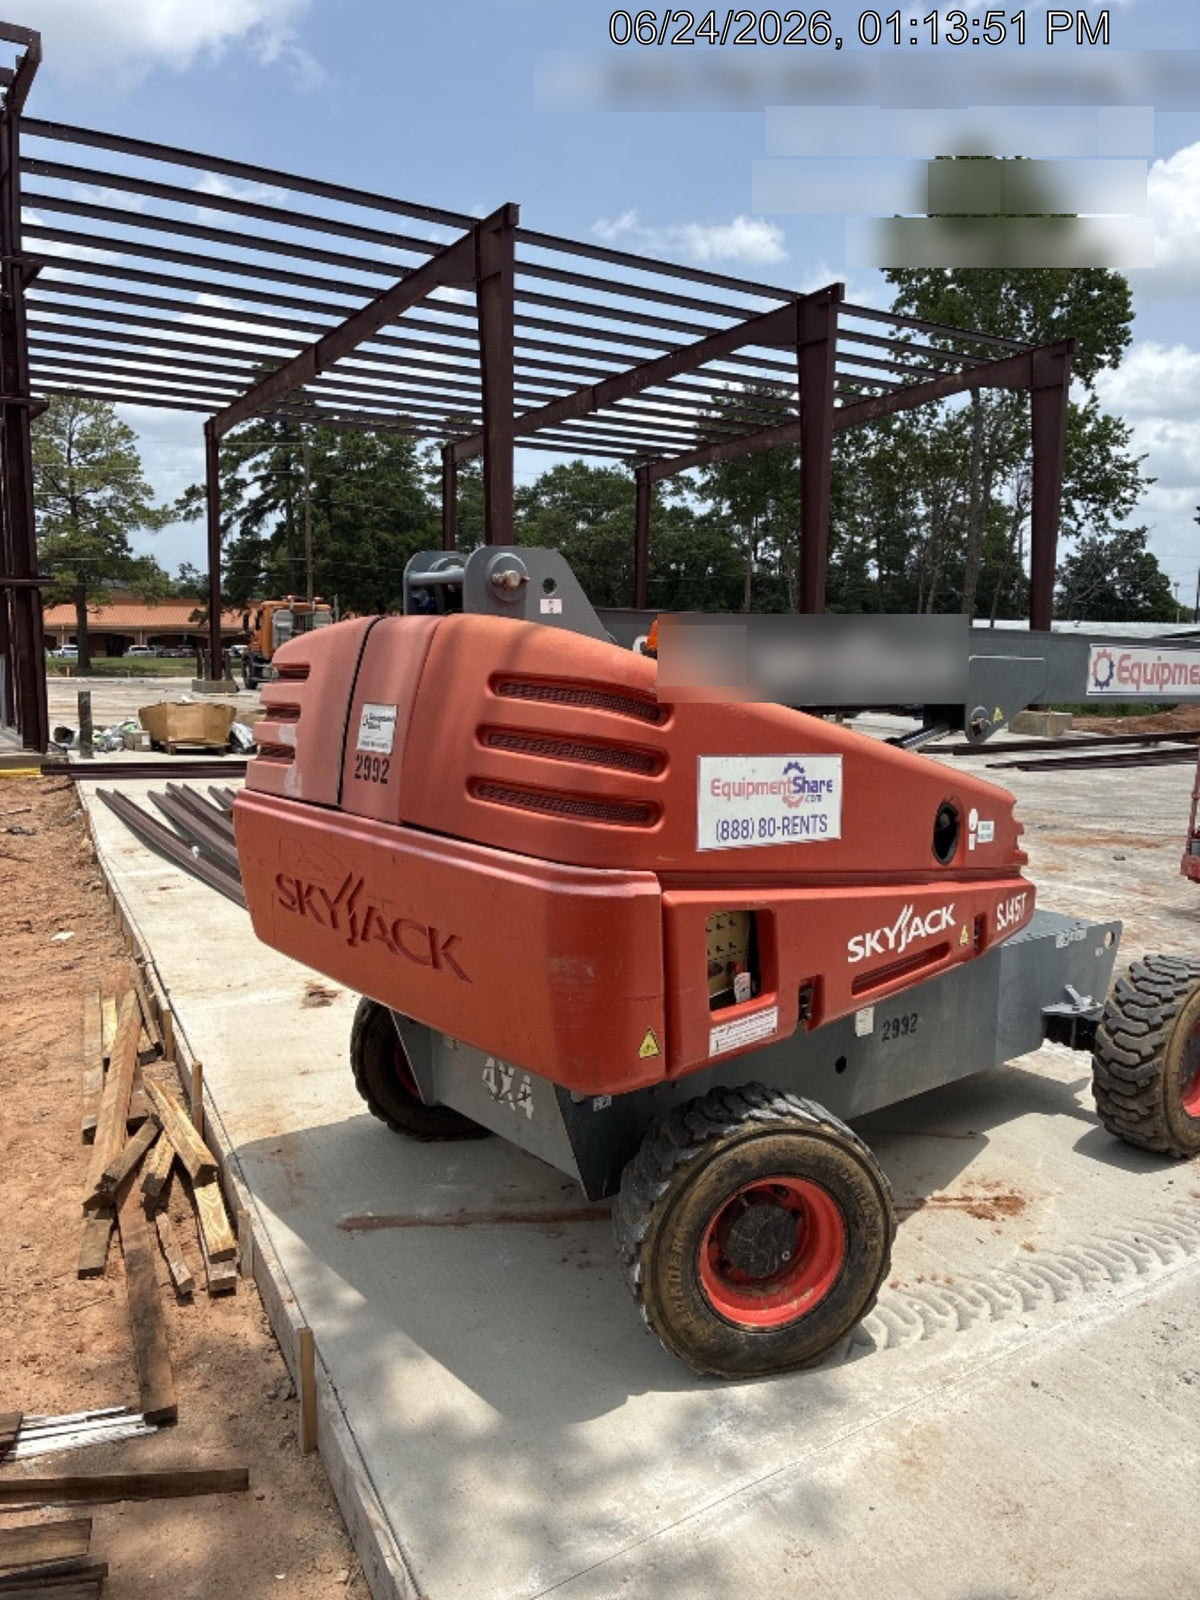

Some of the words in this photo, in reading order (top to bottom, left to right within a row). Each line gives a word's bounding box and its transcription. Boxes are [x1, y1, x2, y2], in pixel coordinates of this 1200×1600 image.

[355, 754, 389, 784] 2992
[710, 776, 833, 801] EquipmentShare
[716, 818, 755, 842] (888)
[758, 814, 828, 838] 80-RENTS
[275, 871, 473, 984] SKYJACK
[847, 903, 956, 963] SKYJACK
[996, 892, 1027, 931] SJ45T
[882, 1013, 918, 1042] 2992
